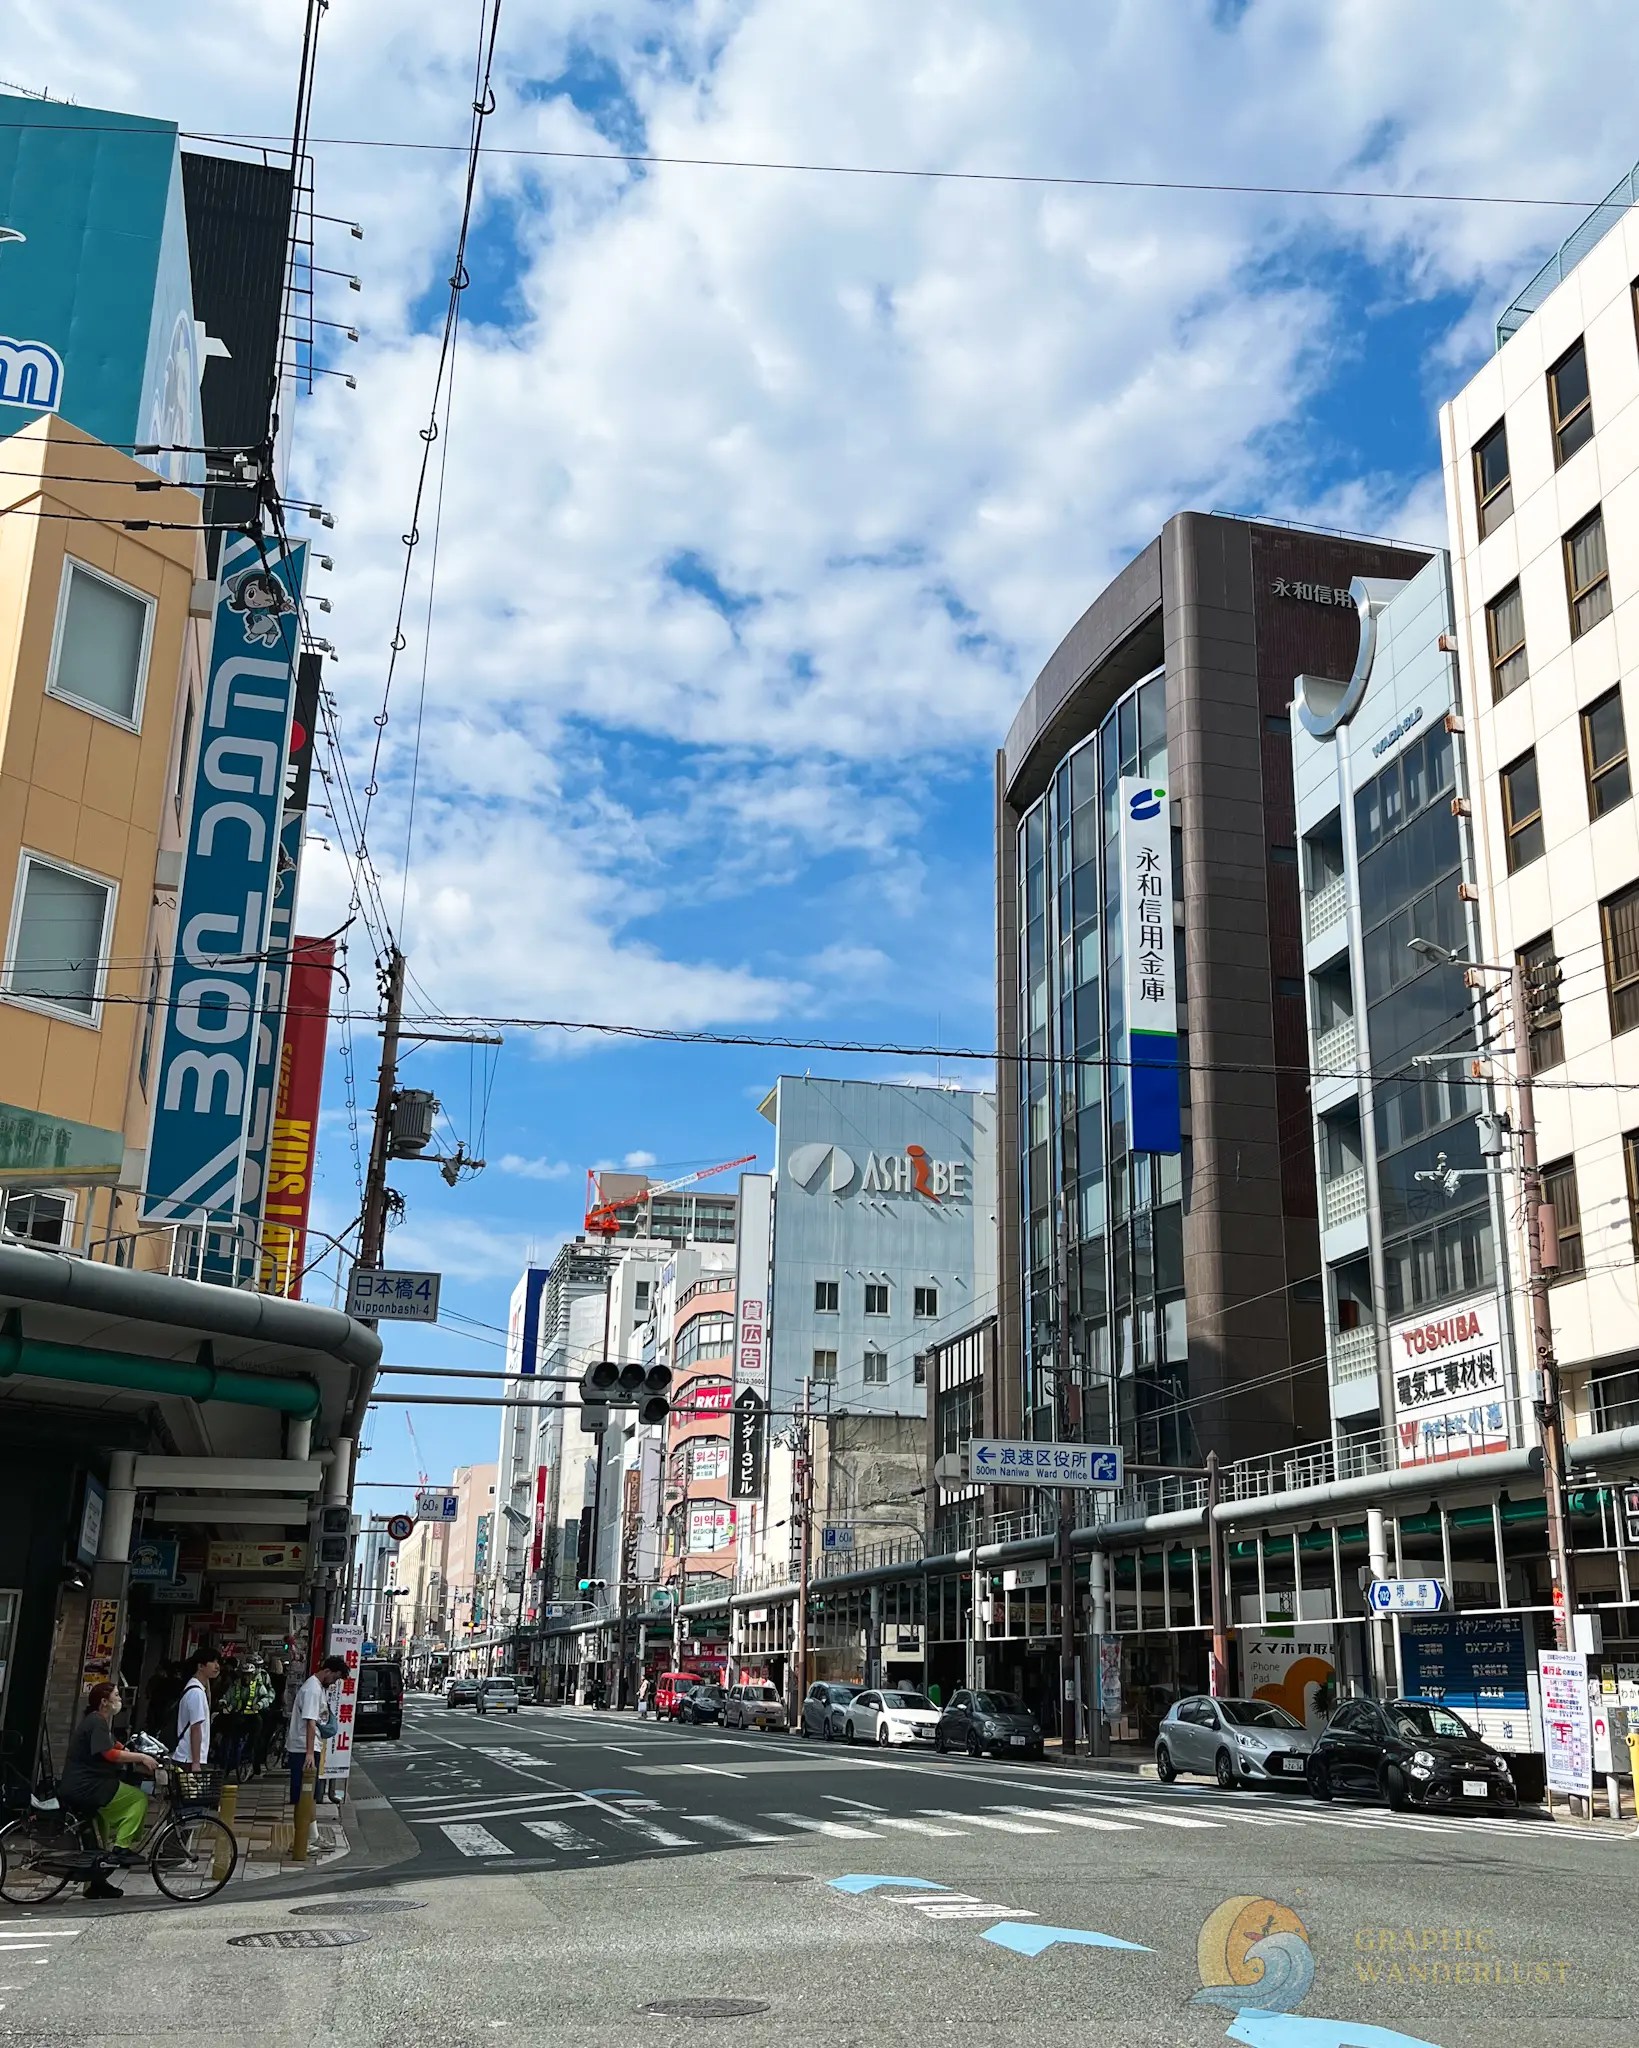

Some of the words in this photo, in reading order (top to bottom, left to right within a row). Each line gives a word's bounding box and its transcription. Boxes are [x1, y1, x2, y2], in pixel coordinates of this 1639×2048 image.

[1272, 577, 1358, 609] 永和信用
[1135, 846, 1166, 1003] 永和信用金庫
[268, 1119, 311, 1195] KIDS
[356, 1275, 432, 1301] 日本橋4
[354, 1299, 430, 1316] Nipponbashi-4
[1402, 1311, 1482, 1356] TOSHIBA
[1397, 1349, 1497, 1405] 電気工事材料
[696, 1449, 728, 1462] 위스키
[1000, 1447, 1088, 1469] 浪速区役所
[976, 1465, 997, 1476] 500m
[1000, 1466, 1029, 1478] Naniwa
[1036, 1468, 1058, 1479] Ward
[1063, 1469, 1088, 1480] Office
[693, 1514, 725, 1527] 의약품
[1379, 1590, 1390, 1602] 102
[1250, 1661, 1281, 1671] iPhone
[1252, 1673, 1270, 1683] iPad
[336, 1650, 359, 1751] 駐車禁止
